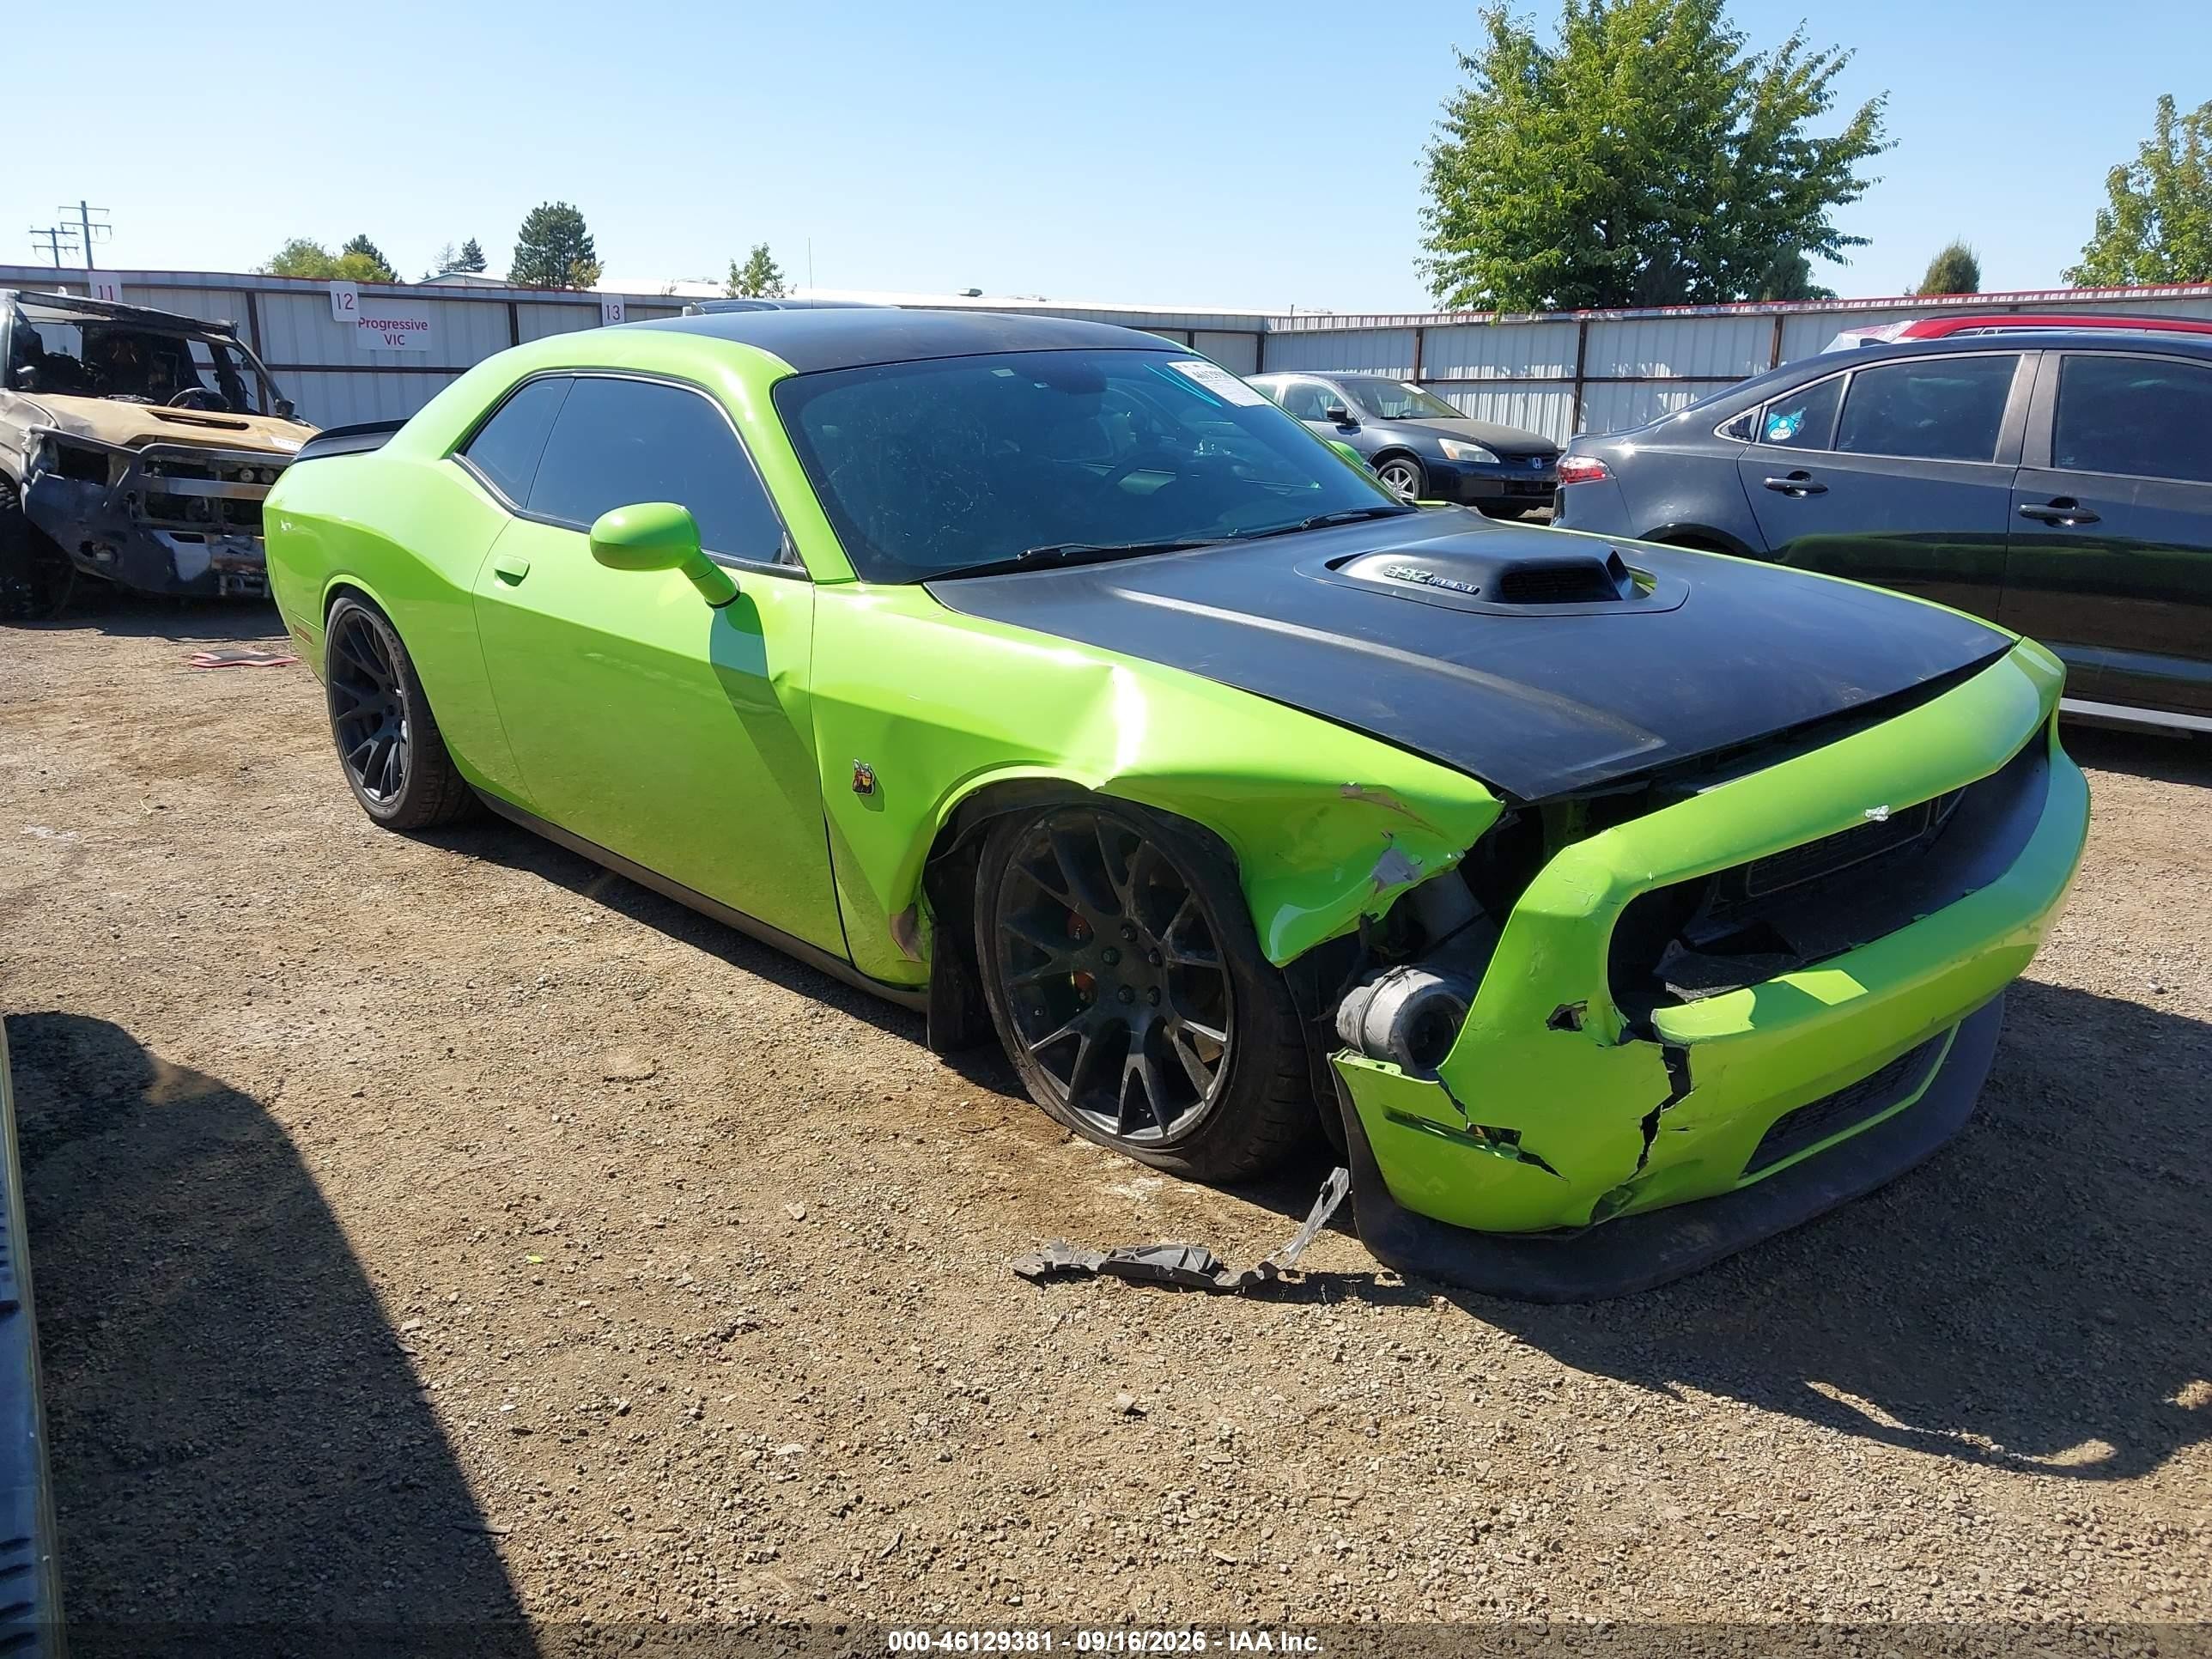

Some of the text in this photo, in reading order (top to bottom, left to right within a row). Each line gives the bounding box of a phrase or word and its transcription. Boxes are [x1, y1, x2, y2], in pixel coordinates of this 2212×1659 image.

[335, 293, 355, 310] 12
[605, 304, 621, 320] 13
[357, 317, 428, 331] Progressive
[384, 334, 405, 346] VIC
[1428, 576, 1481, 596] HEMI
